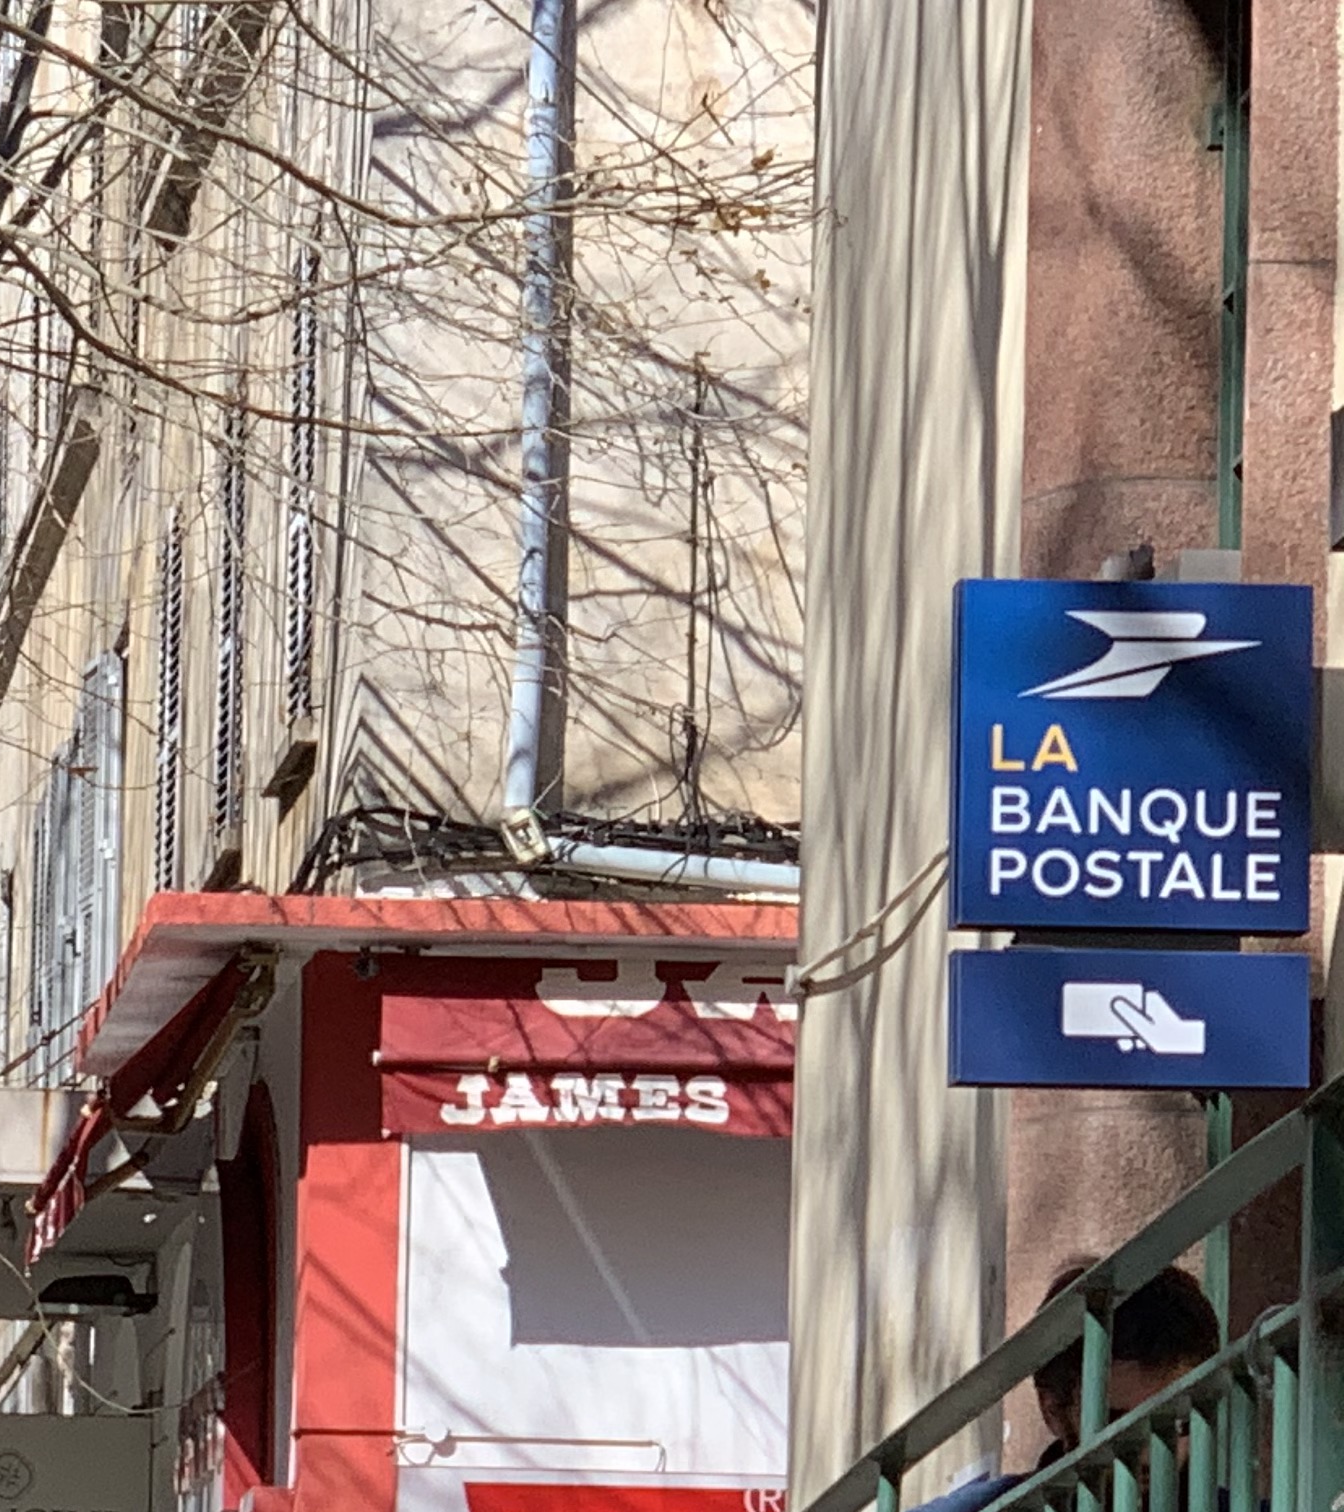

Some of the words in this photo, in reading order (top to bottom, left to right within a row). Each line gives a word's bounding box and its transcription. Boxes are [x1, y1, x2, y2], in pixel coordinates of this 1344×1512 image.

[990, 723, 1078, 772] LA
[990, 786, 1282, 843] BANQUE
[989, 848, 1281, 901] POSTALE
[440, 1072, 729, 1125] JAMES
